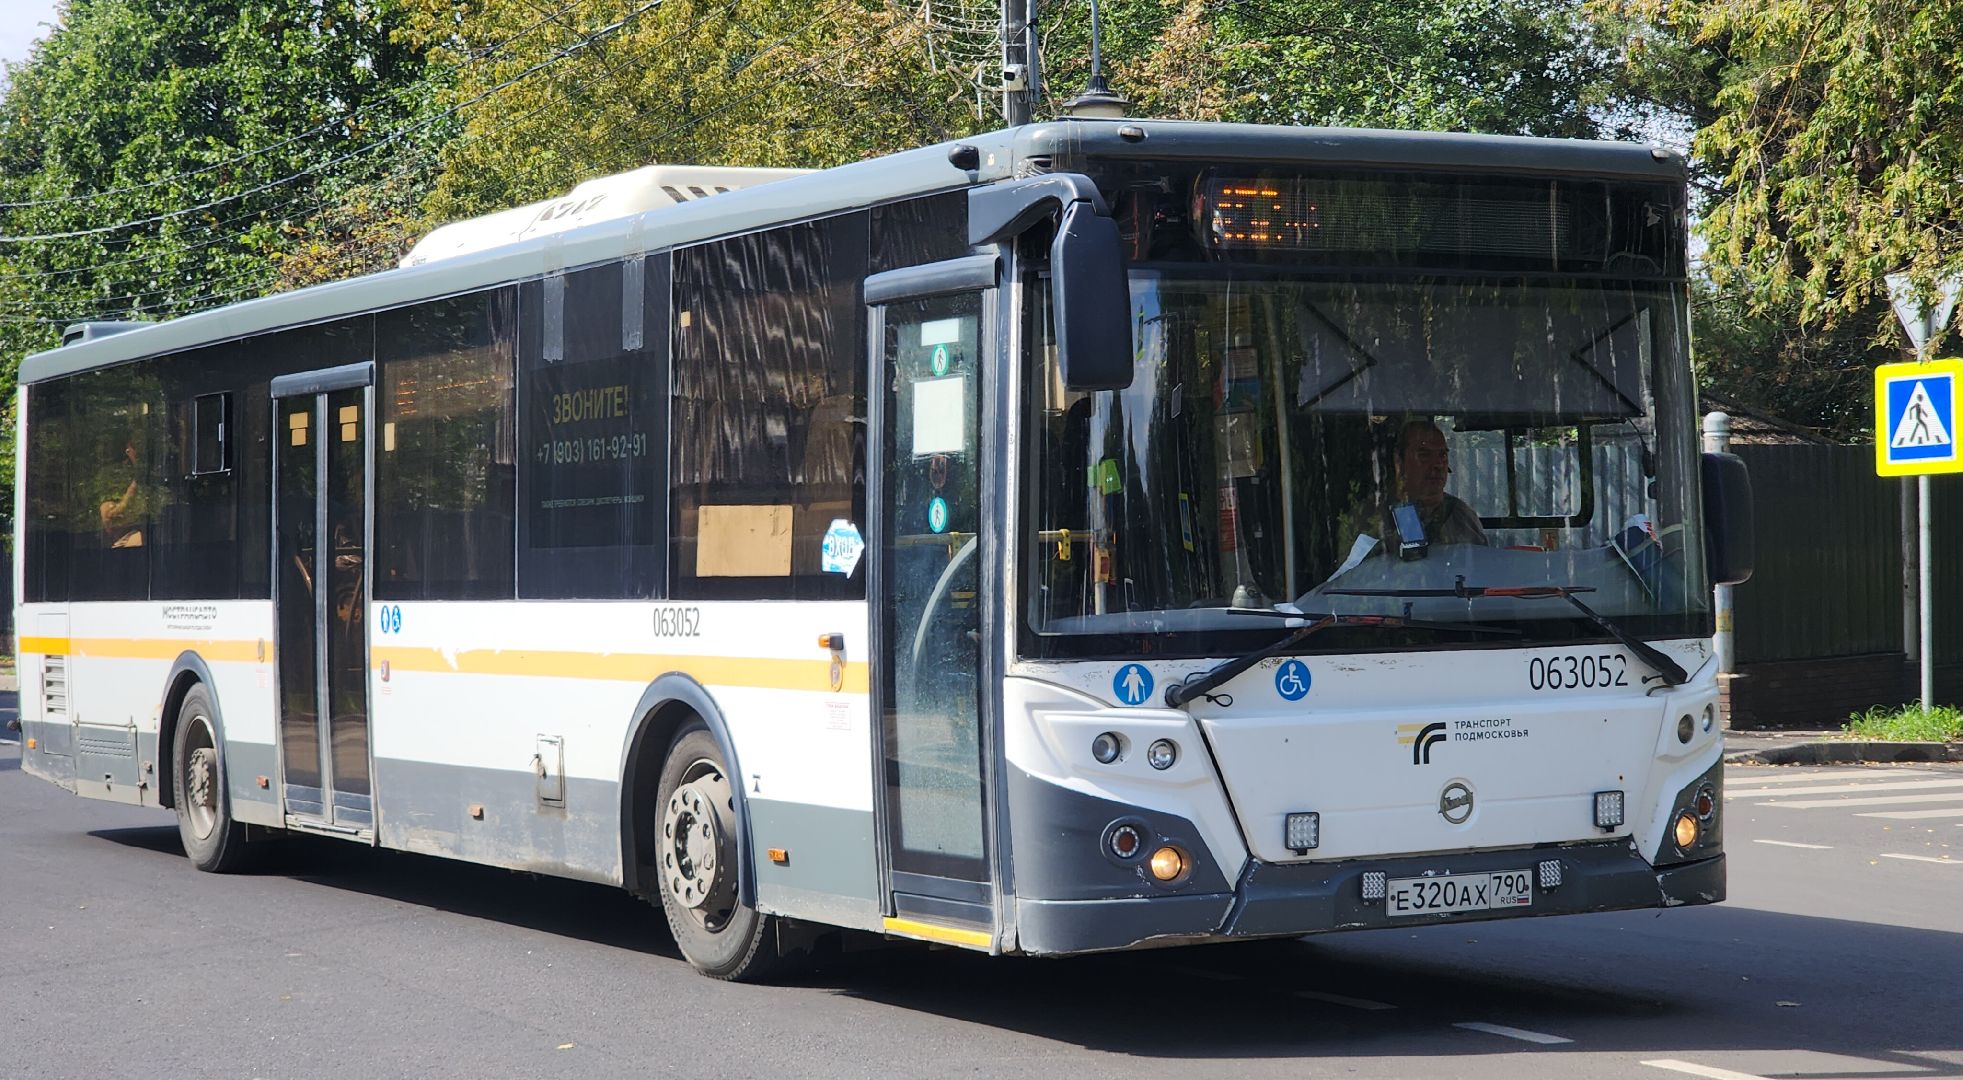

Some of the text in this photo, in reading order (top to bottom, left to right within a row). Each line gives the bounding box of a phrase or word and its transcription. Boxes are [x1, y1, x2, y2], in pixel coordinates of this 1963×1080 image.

[553, 385, 629, 424] ЗВОНИТЕ!
[537, 432, 646, 465] +7 (903) 161-92-91
[653, 607, 701, 638] 063052
[1529, 654, 1628, 690] 063052
[1454, 718, 1511, 730] ТРАНСПОРТ
[1455, 729, 1529, 742] ПОДМОСКОВЬЯ
[1492, 874, 1526, 896] 790
[1500, 896, 1517, 905] RUS
